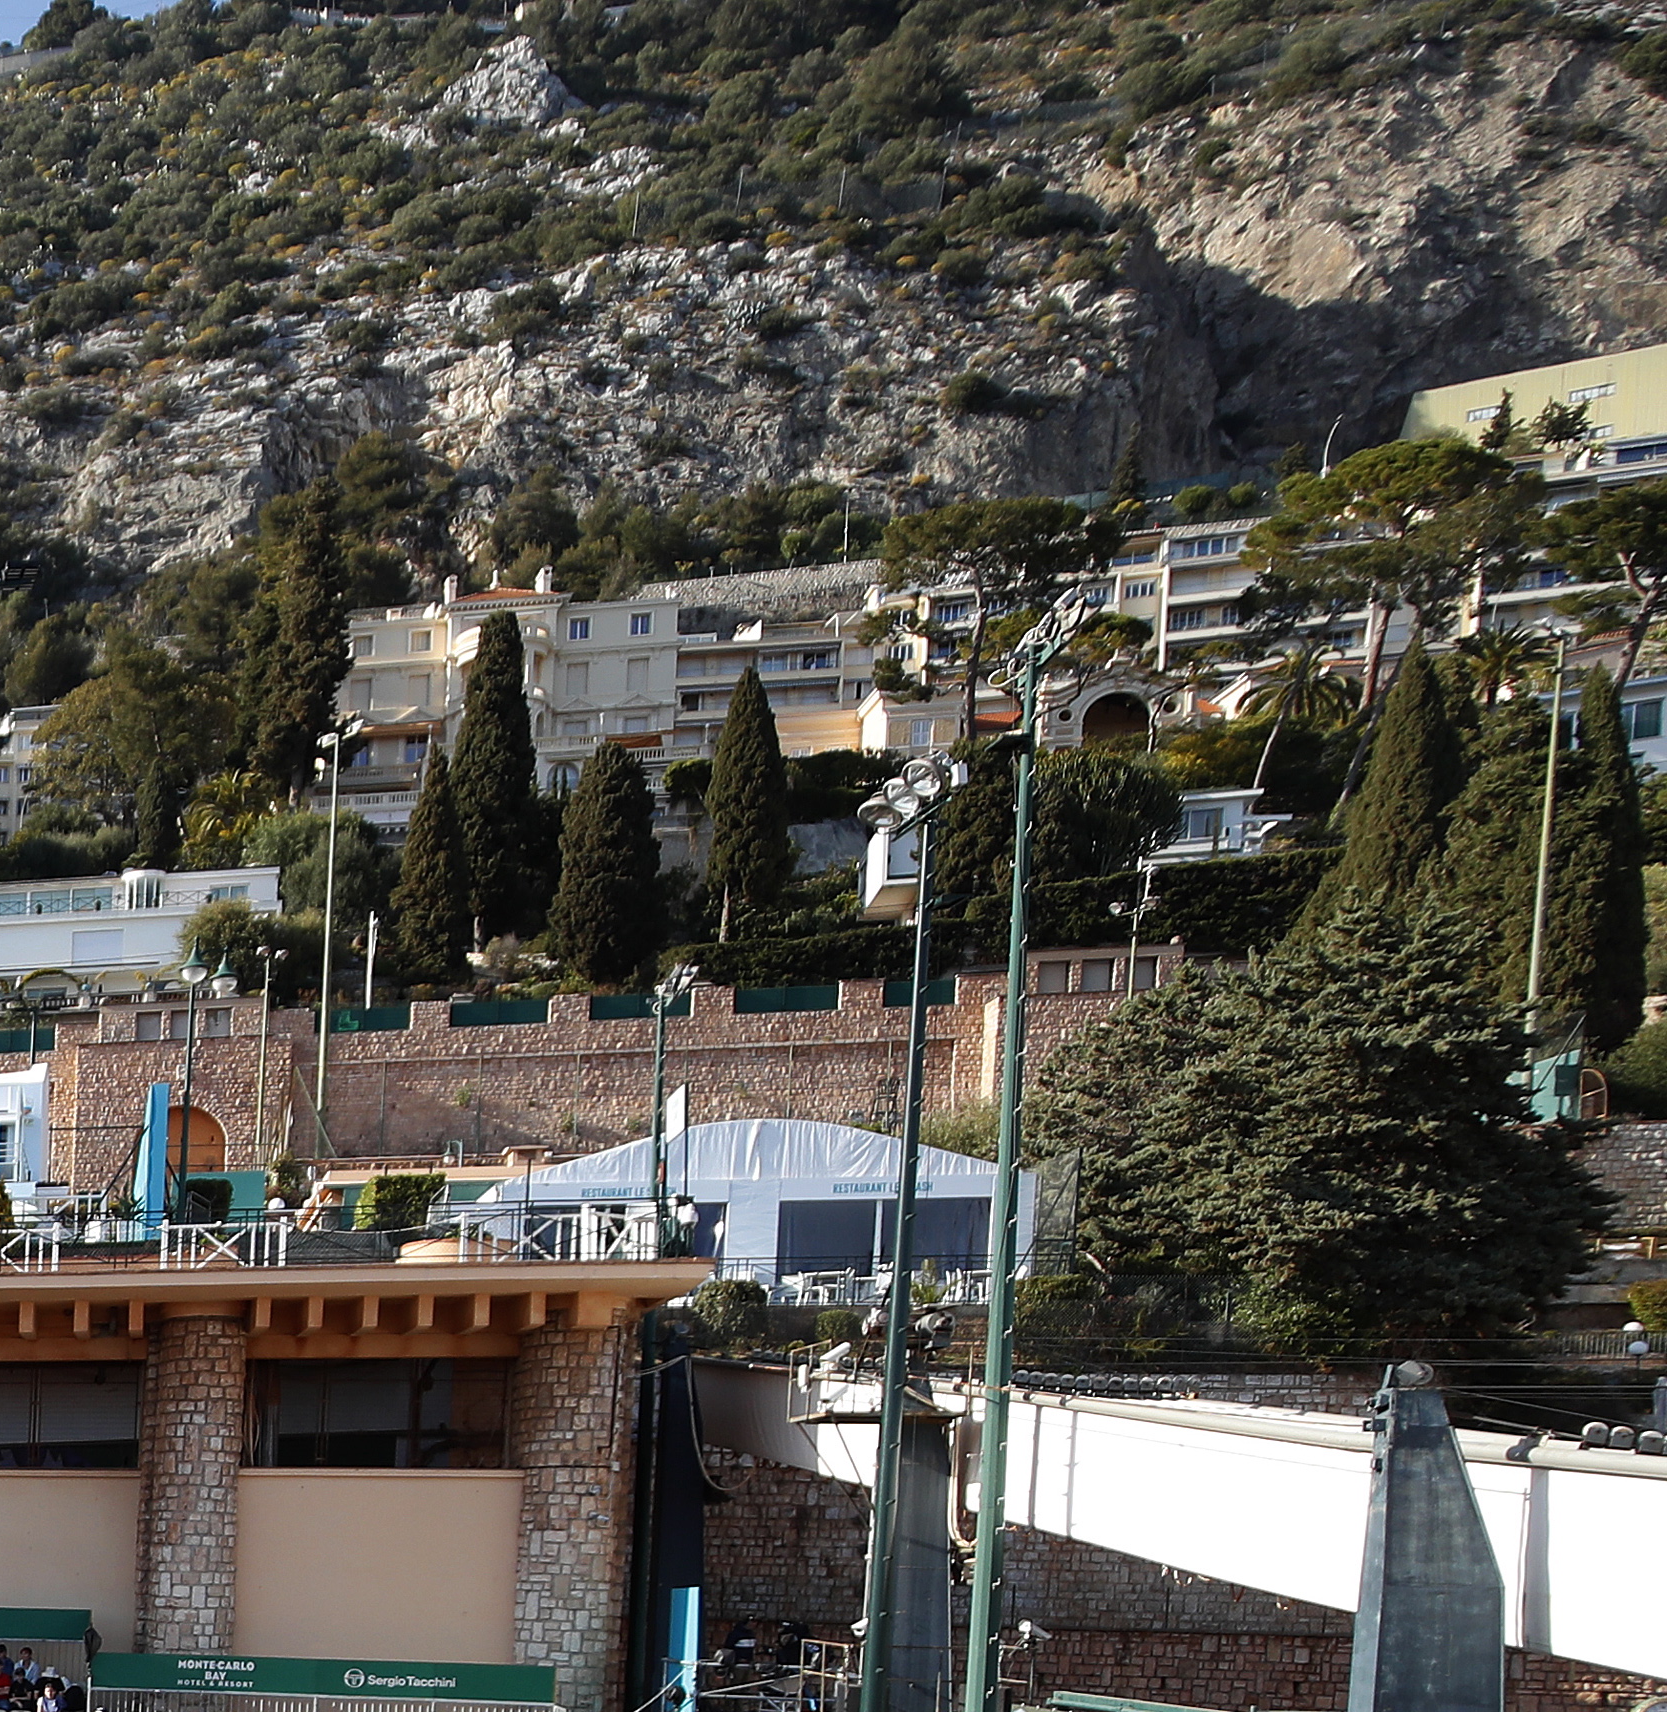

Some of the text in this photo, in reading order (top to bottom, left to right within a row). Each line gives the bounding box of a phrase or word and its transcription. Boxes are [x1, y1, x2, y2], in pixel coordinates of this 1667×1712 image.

[581, 1187, 633, 1198] RESTAURANT
[833, 1182, 886, 1194] RESTAURANT
[205, 1671, 226, 1681] BAY
[368, 1674, 456, 1688] Sergio Tacchini
